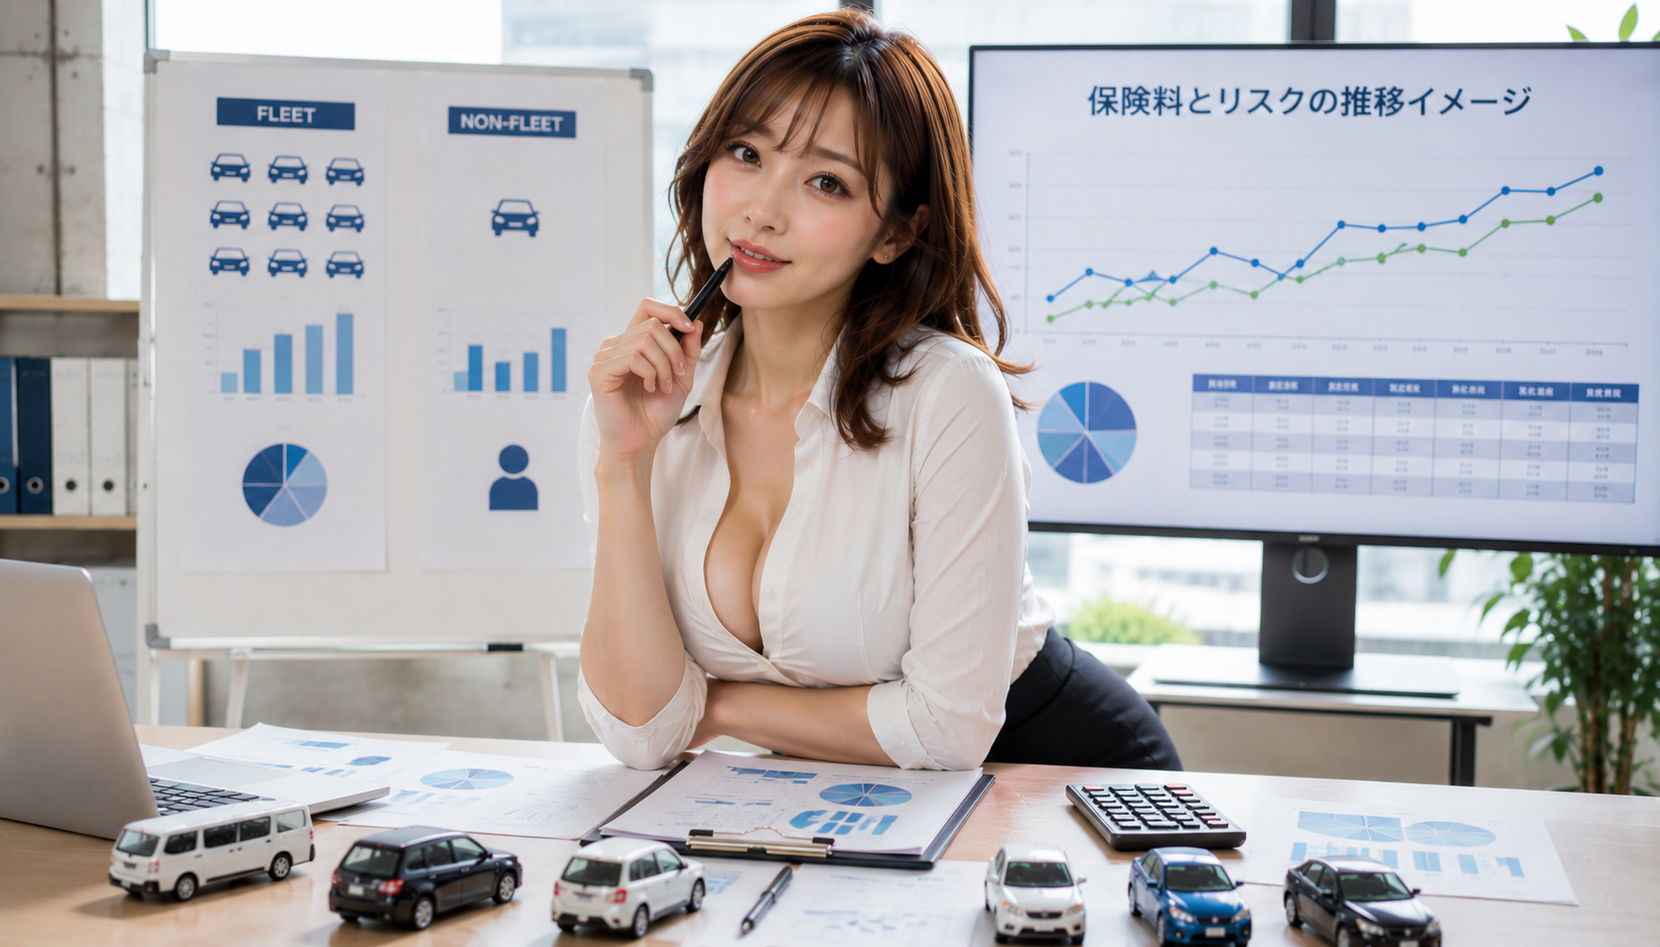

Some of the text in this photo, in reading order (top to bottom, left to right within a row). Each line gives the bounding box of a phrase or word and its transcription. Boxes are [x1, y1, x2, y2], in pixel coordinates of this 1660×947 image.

[1087, 85, 1532, 118] 保険料とリスクの推移イメージ
[256, 105, 317, 124] FLEET
[459, 112, 565, 133] NON-FLEET
